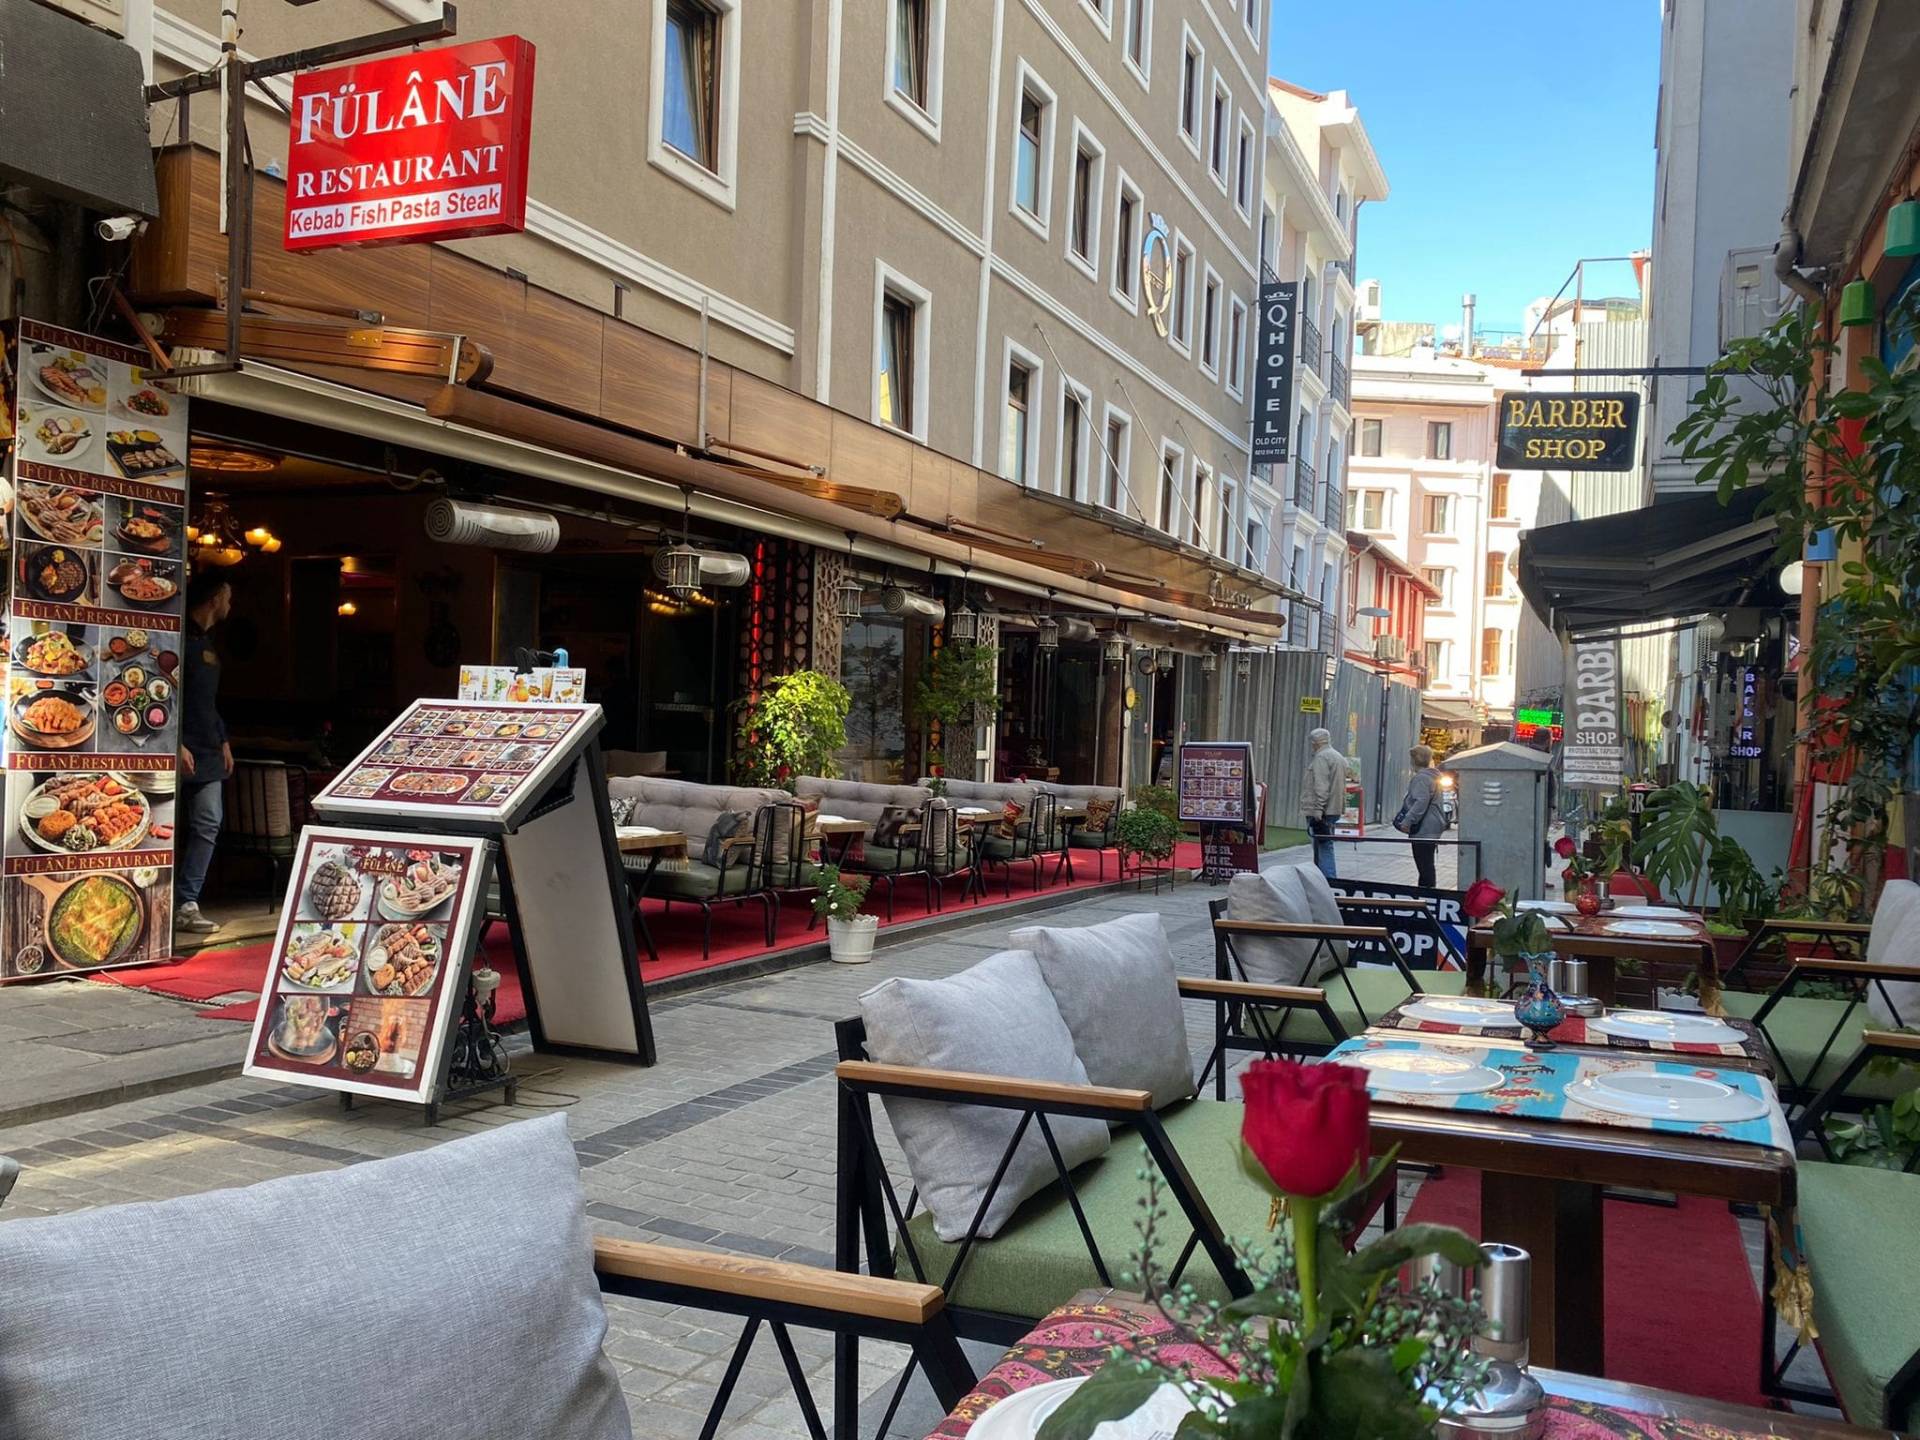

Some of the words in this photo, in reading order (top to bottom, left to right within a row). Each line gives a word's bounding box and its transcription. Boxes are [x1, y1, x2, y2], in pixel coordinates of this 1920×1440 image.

[296, 62, 507, 145] FÜLÂNE
[296, 144, 504, 198] RESTAURANT
[290, 208, 344, 234] Kebab
[350, 201, 388, 228] Fish
[390, 198, 441, 222] Pasta
[446, 187, 500, 214] Steak
[1264, 332, 1286, 434] HOTEL
[1505, 399, 1628, 429] BARBER
[1255, 437, 1270, 446] OLD
[1270, 436, 1287, 446] CITY
[1525, 438, 1606, 460] SHOP
[91, 477, 181, 505] RESTAURANT
[86, 609, 179, 631] RESTAURANT
[1575, 731, 1617, 745] SHOP
[1730, 746, 1762, 757] SHOP
[81, 757, 172, 771] RESTAURANT
[78, 853, 171, 869] RESTAURANT
